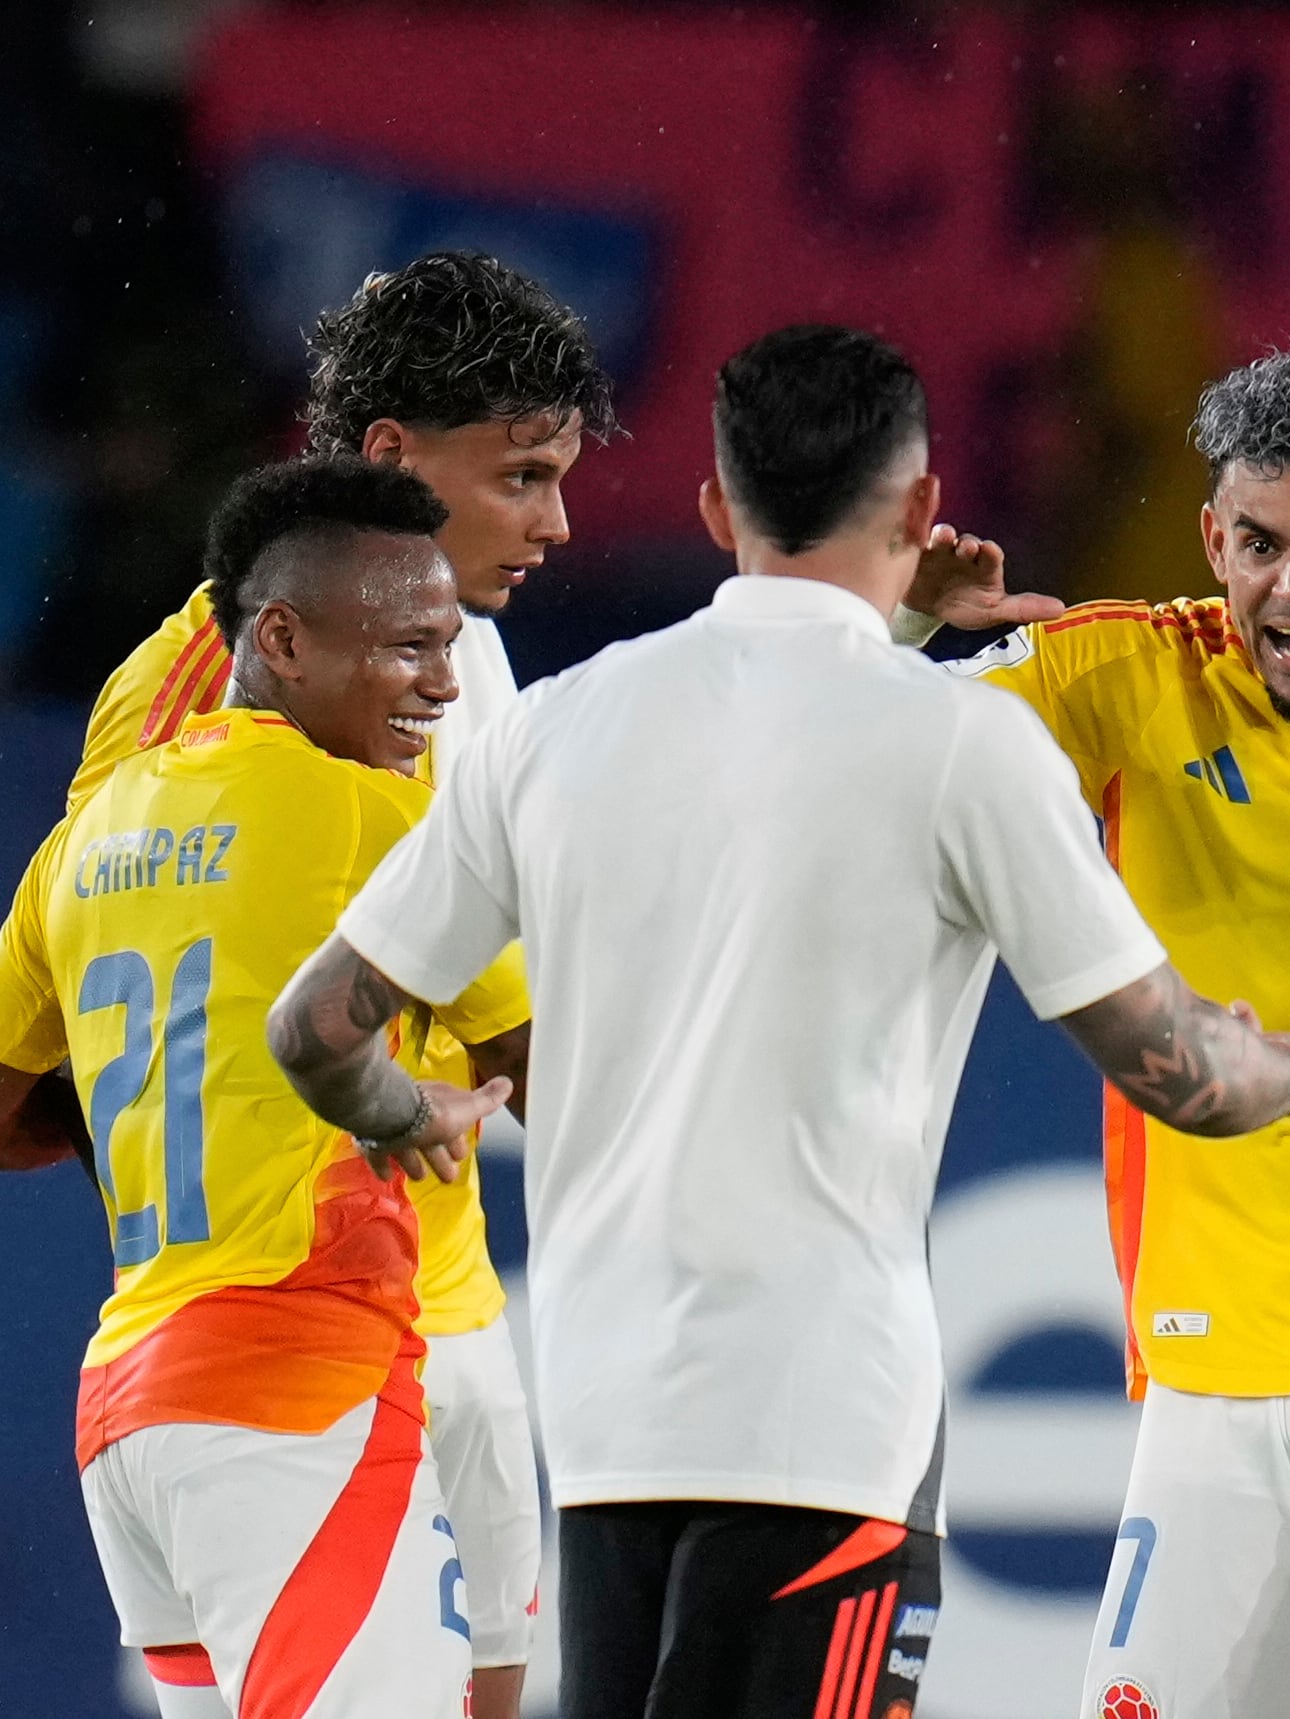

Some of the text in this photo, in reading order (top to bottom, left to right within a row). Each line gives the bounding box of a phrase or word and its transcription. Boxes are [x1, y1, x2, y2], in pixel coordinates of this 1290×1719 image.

[75, 824, 238, 898] CAMPAZ
[78, 937, 212, 1268] 21
[1109, 1516, 1157, 1648] 7
